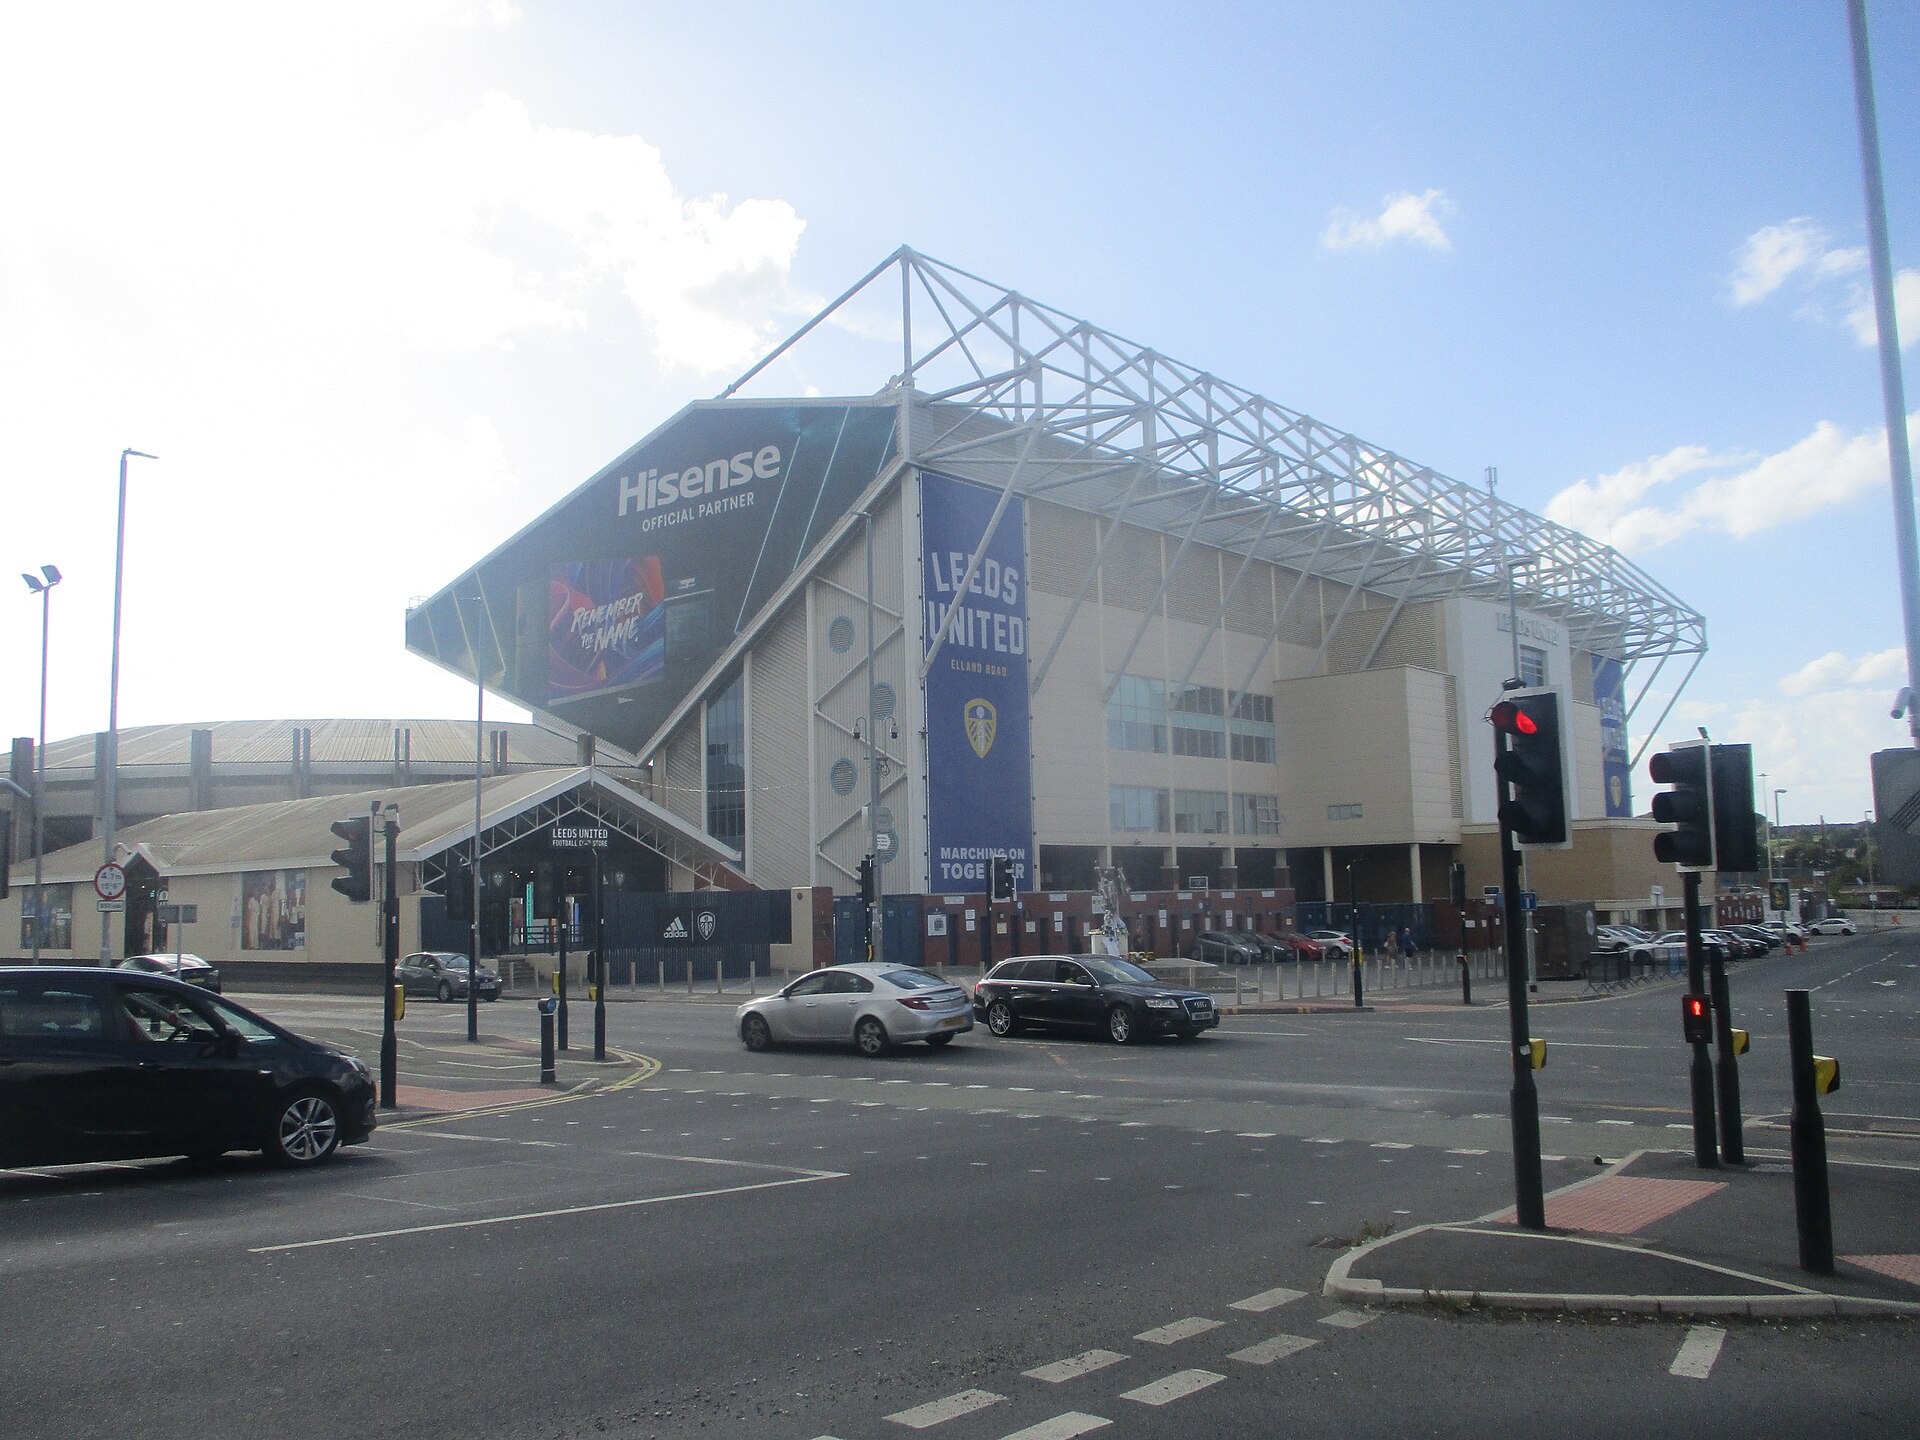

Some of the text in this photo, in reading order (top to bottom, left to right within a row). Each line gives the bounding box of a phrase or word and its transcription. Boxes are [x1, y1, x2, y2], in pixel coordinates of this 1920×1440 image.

[618, 445, 781, 517] Hisense
[642, 491, 754, 532] OFFICIAL PARTNER
[931, 551, 1019, 606] LEEDS
[571, 592, 643, 634] REMEMBER
[928, 600, 1025, 655] UNITED
[1496, 612, 1530, 637] LEDS
[951, 659, 1008, 677] ELLAND ROAD
[552, 828, 608, 839] LEEDS UNITED
[552, 839, 578, 847] FOOTBALL
[940, 847, 1025, 860] MARCHING ON
[940, 862, 1025, 880] TOGER
[663, 930, 688, 938] adidas
